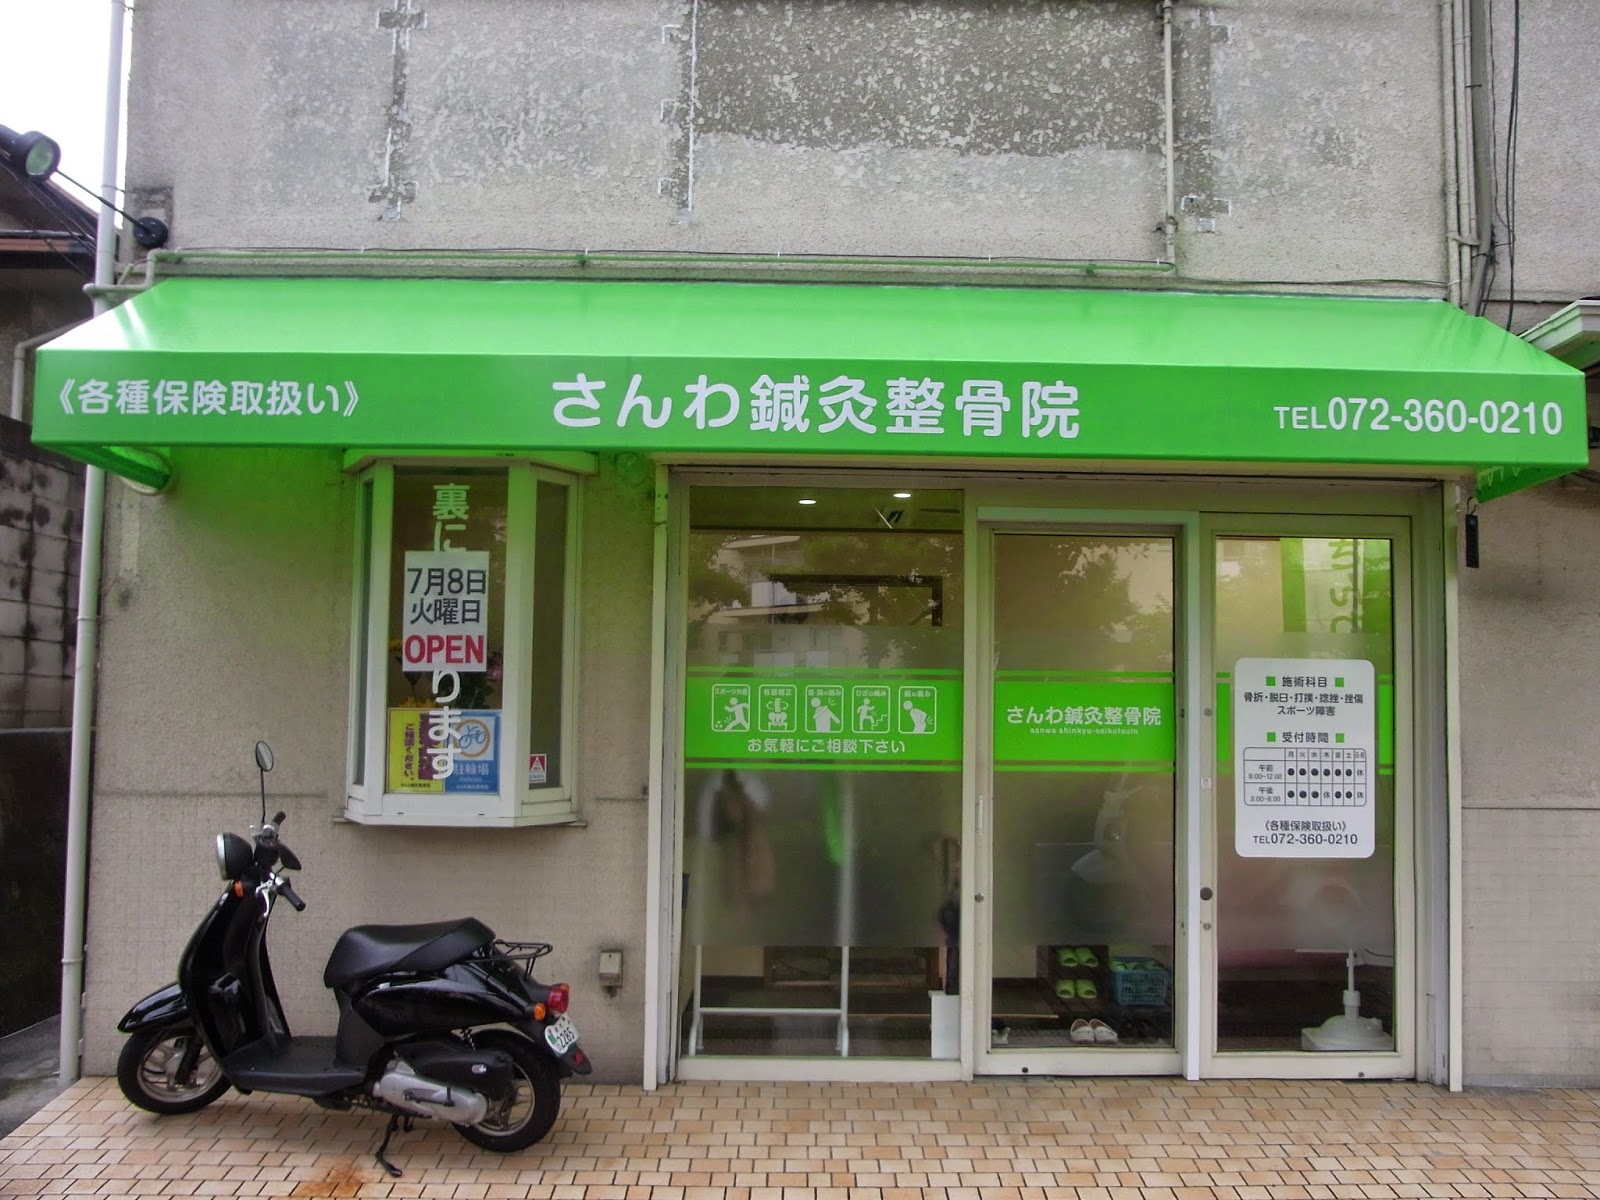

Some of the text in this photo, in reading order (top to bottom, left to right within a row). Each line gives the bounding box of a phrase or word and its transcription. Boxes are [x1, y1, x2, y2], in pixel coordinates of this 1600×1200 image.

[57, 378, 362, 419] 《各種保険取扱い》
[552, 372, 1081, 440] さんわ鍼灸整骨院
[406, 567, 487, 597] 7月8日
[410, 598, 480, 625] 火曜日
[404, 633, 485, 665] OPEN
[1282, 676, 1328, 688] 施術科目
[1006, 706, 1162, 726] さんわ鍼灸整骨院
[1277, 706, 1336, 716] スポーツ障害
[747, 737, 907, 754] お気軽にご相談下さい
[1282, 732, 1329, 743] 受付時間
[1258, 764, 1273, 772] 午前
[1356, 769, 1364, 777] 休
[1258, 786, 1273, 794] 午後
[1323, 791, 1331, 799] 休
[557, 1027, 574, 1047] 2285
